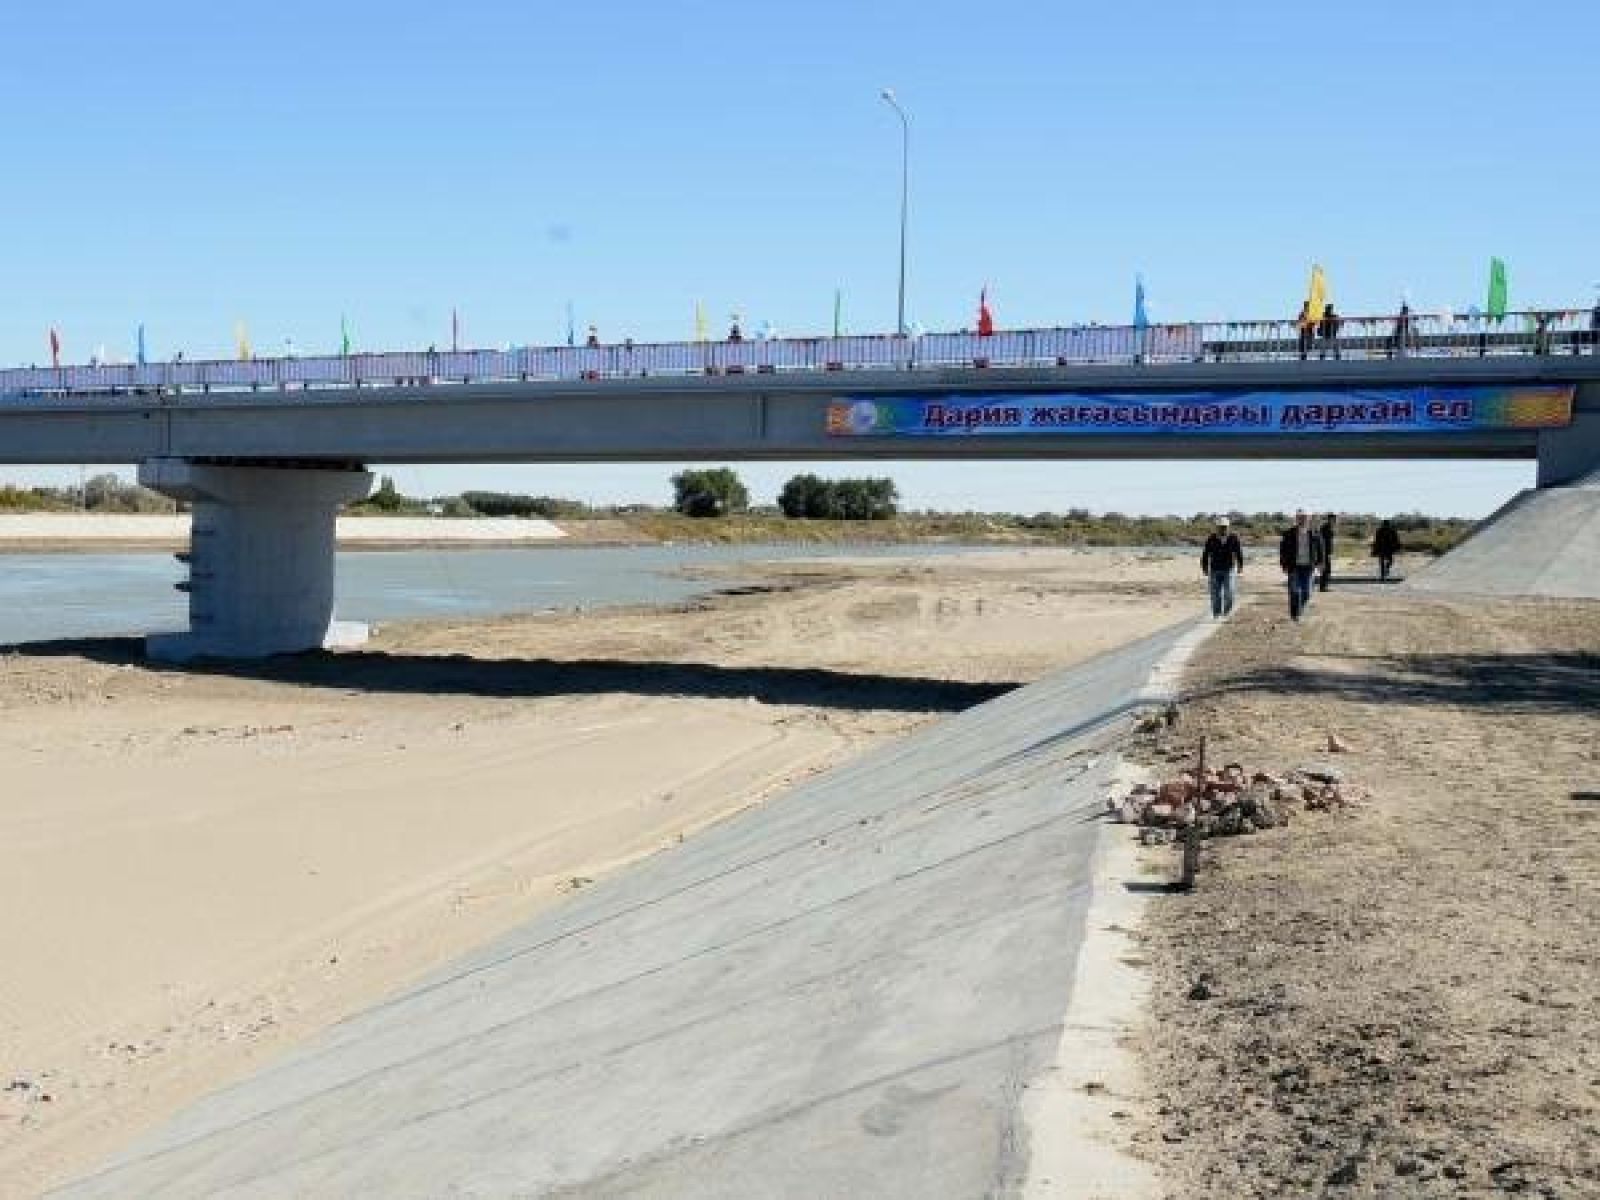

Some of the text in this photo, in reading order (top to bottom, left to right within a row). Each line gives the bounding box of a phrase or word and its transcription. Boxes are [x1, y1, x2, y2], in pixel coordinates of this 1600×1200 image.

[925, 404, 1020, 429] Дария
[1281, 401, 1413, 429] дархан
[1427, 399, 1471, 421] ел
